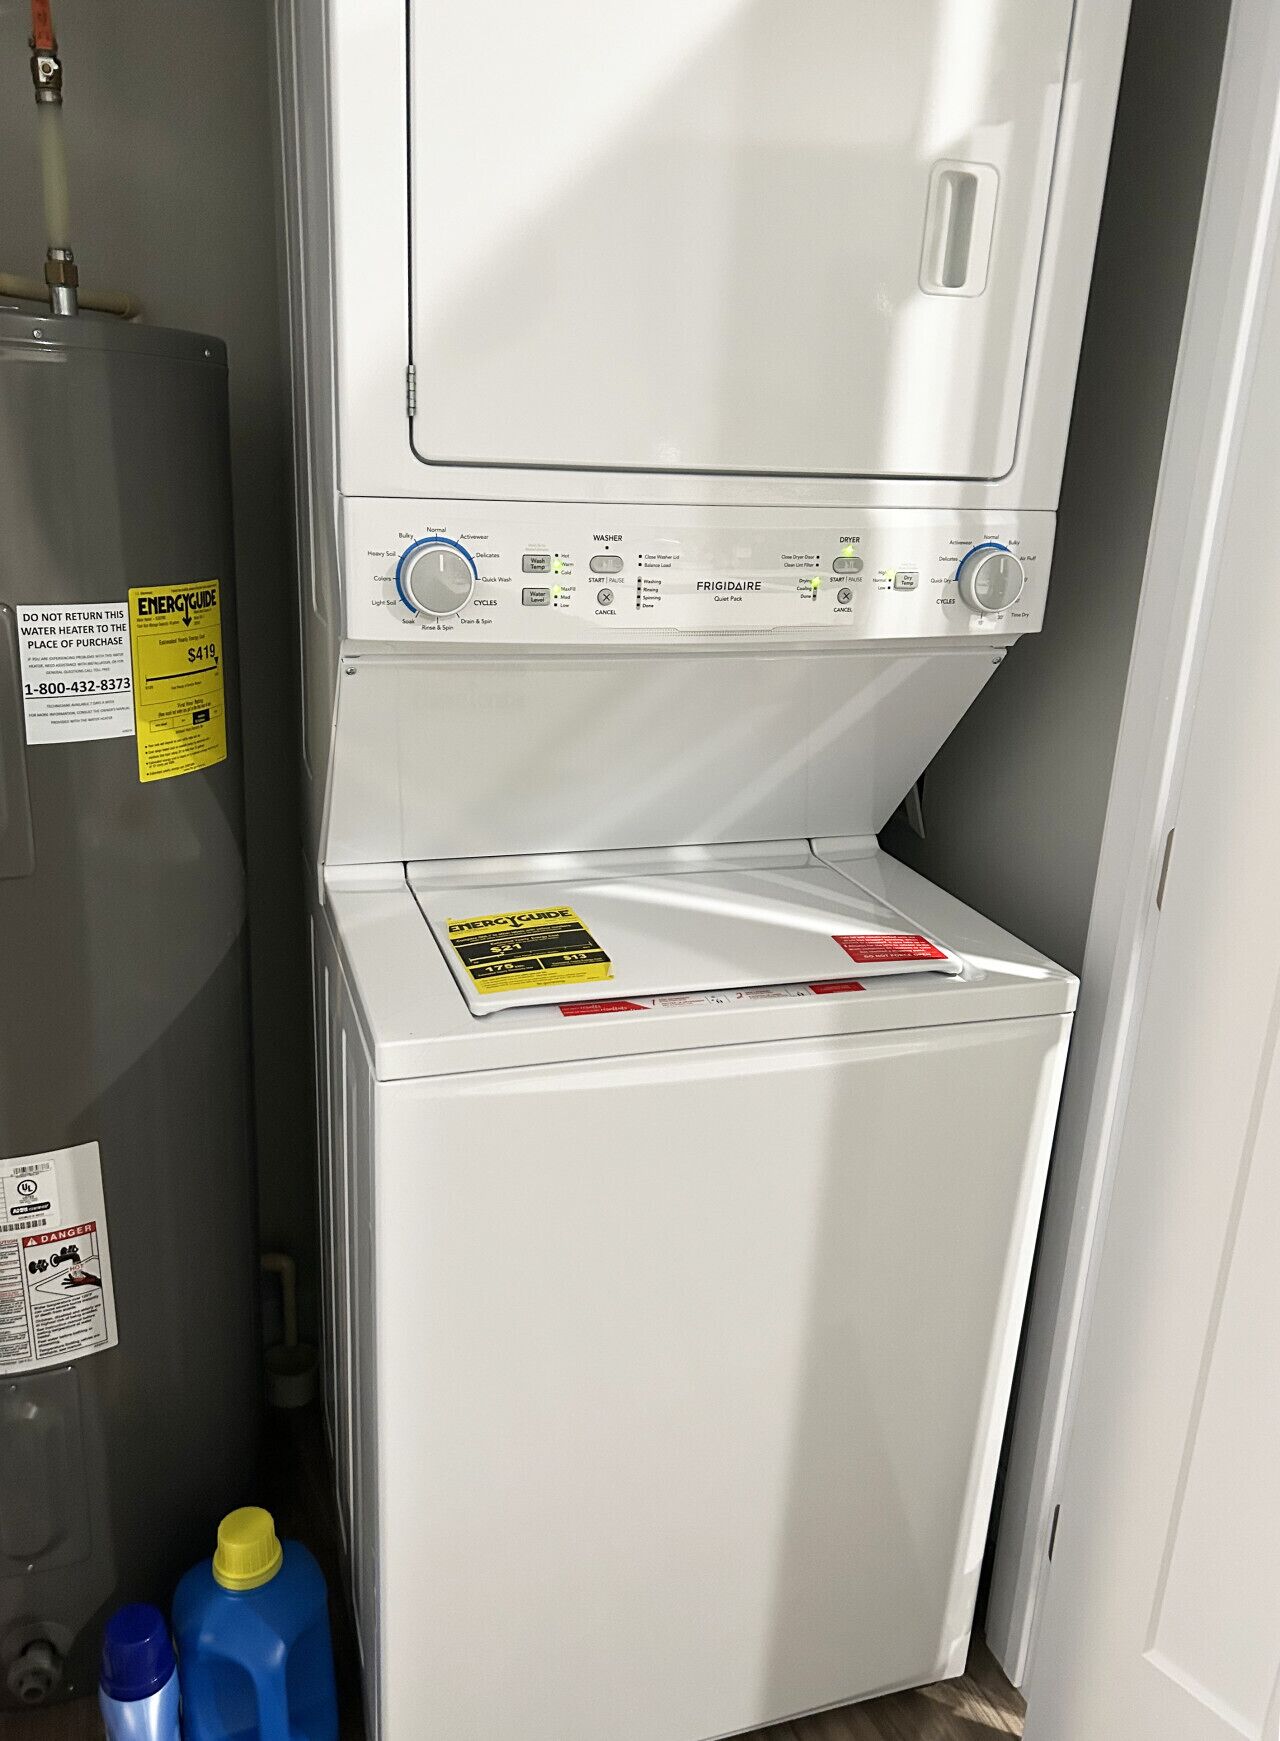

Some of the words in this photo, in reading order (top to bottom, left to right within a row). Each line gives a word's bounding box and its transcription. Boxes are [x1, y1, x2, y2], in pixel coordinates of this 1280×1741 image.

[696, 581, 762, 590] FRIGIDAIRE
[138, 589, 216, 617] ENERGYGUIDE
[23, 613, 39, 622] DO
[42, 613, 63, 621] NOT
[65, 612, 103, 621] RETURN
[105, 610, 124, 619] THIS
[21, 627, 56, 636] WATER
[59, 625, 95, 635] HEATER
[97, 624, 109, 633] TO
[110, 623, 127, 632] THE
[28, 640, 58, 649] PLACE
[61, 639, 74, 648] OF
[76, 637, 123, 647] PURCHASE
[188, 644, 215, 663] $419
[24, 678, 131, 695] 1-800-432-8373
[449, 910, 573, 932] ENERGYGUIDE
[490, 944, 522, 953] $21
[22, 1183, 33, 1192] UL
[41, 1224, 92, 1243] DANGER
